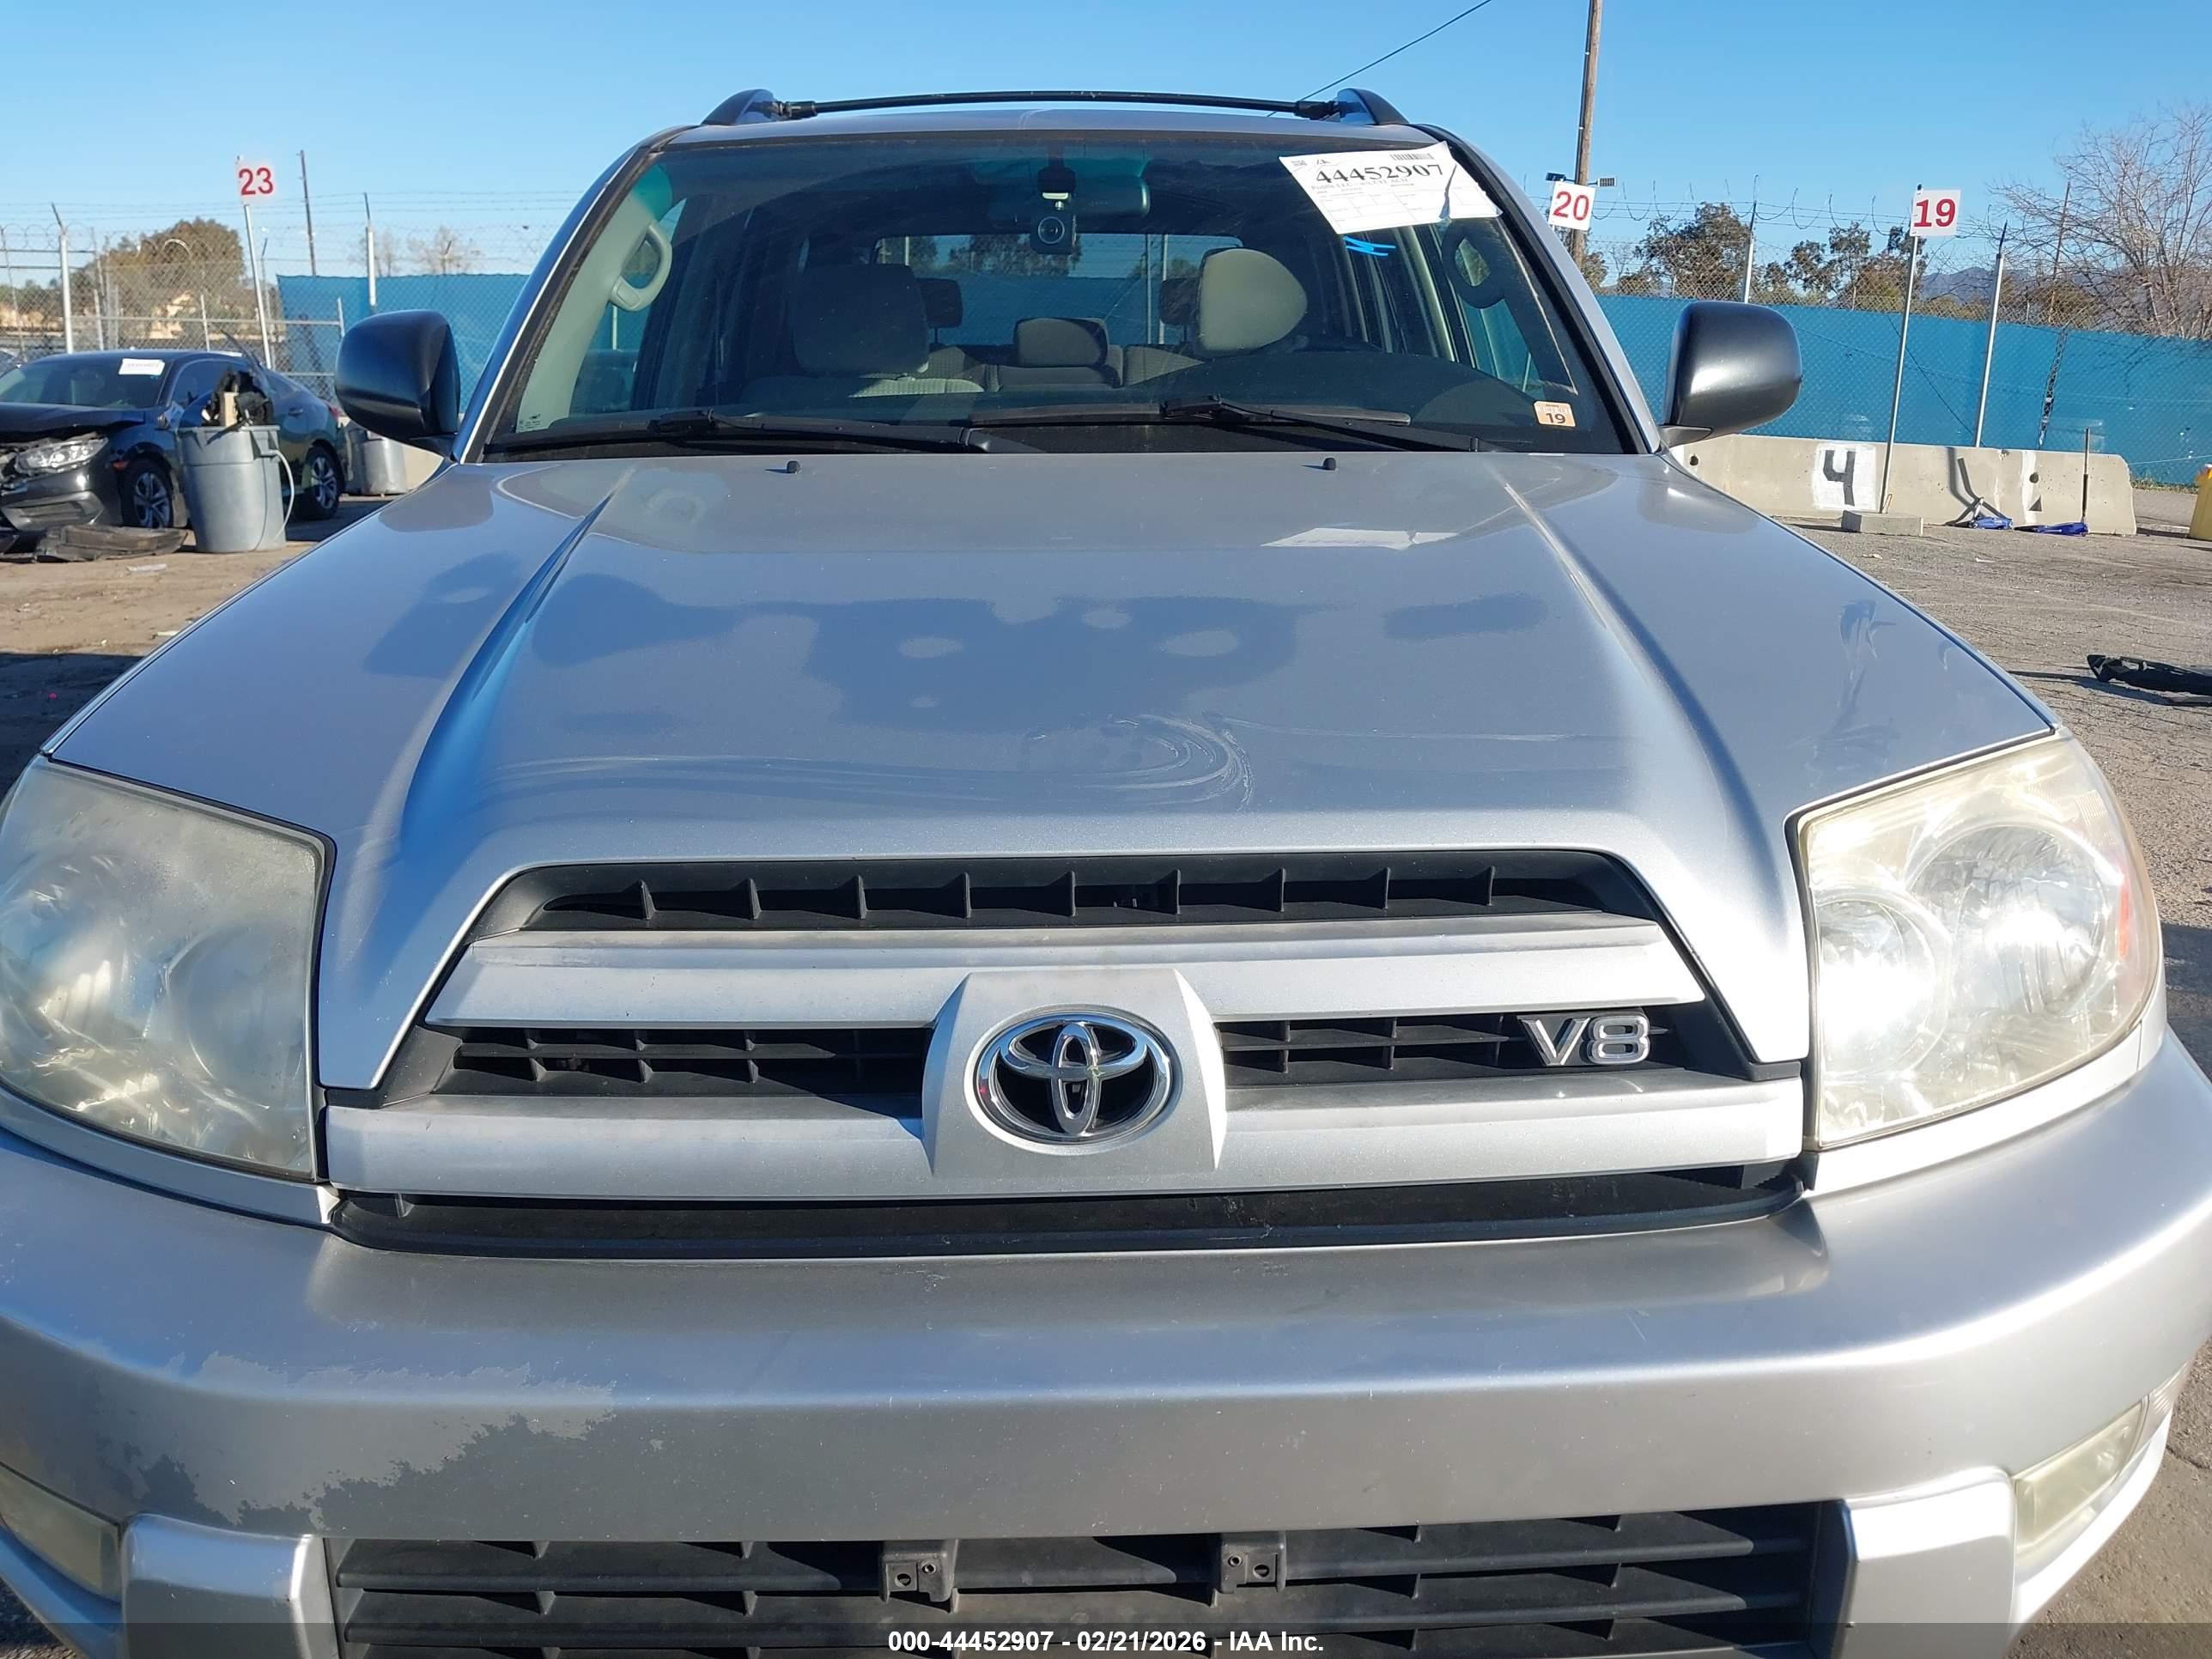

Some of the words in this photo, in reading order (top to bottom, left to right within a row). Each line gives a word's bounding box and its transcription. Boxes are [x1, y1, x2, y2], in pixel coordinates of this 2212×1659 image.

[239, 167, 274, 195] 23
[1316, 164, 1443, 183] 44452907
[1553, 191, 1589, 221] 20
[1913, 198, 1956, 228] 19
[1545, 412, 1566, 423] 19
[1823, 449, 1856, 507] 4
[1517, 1015, 1650, 1066] V8
